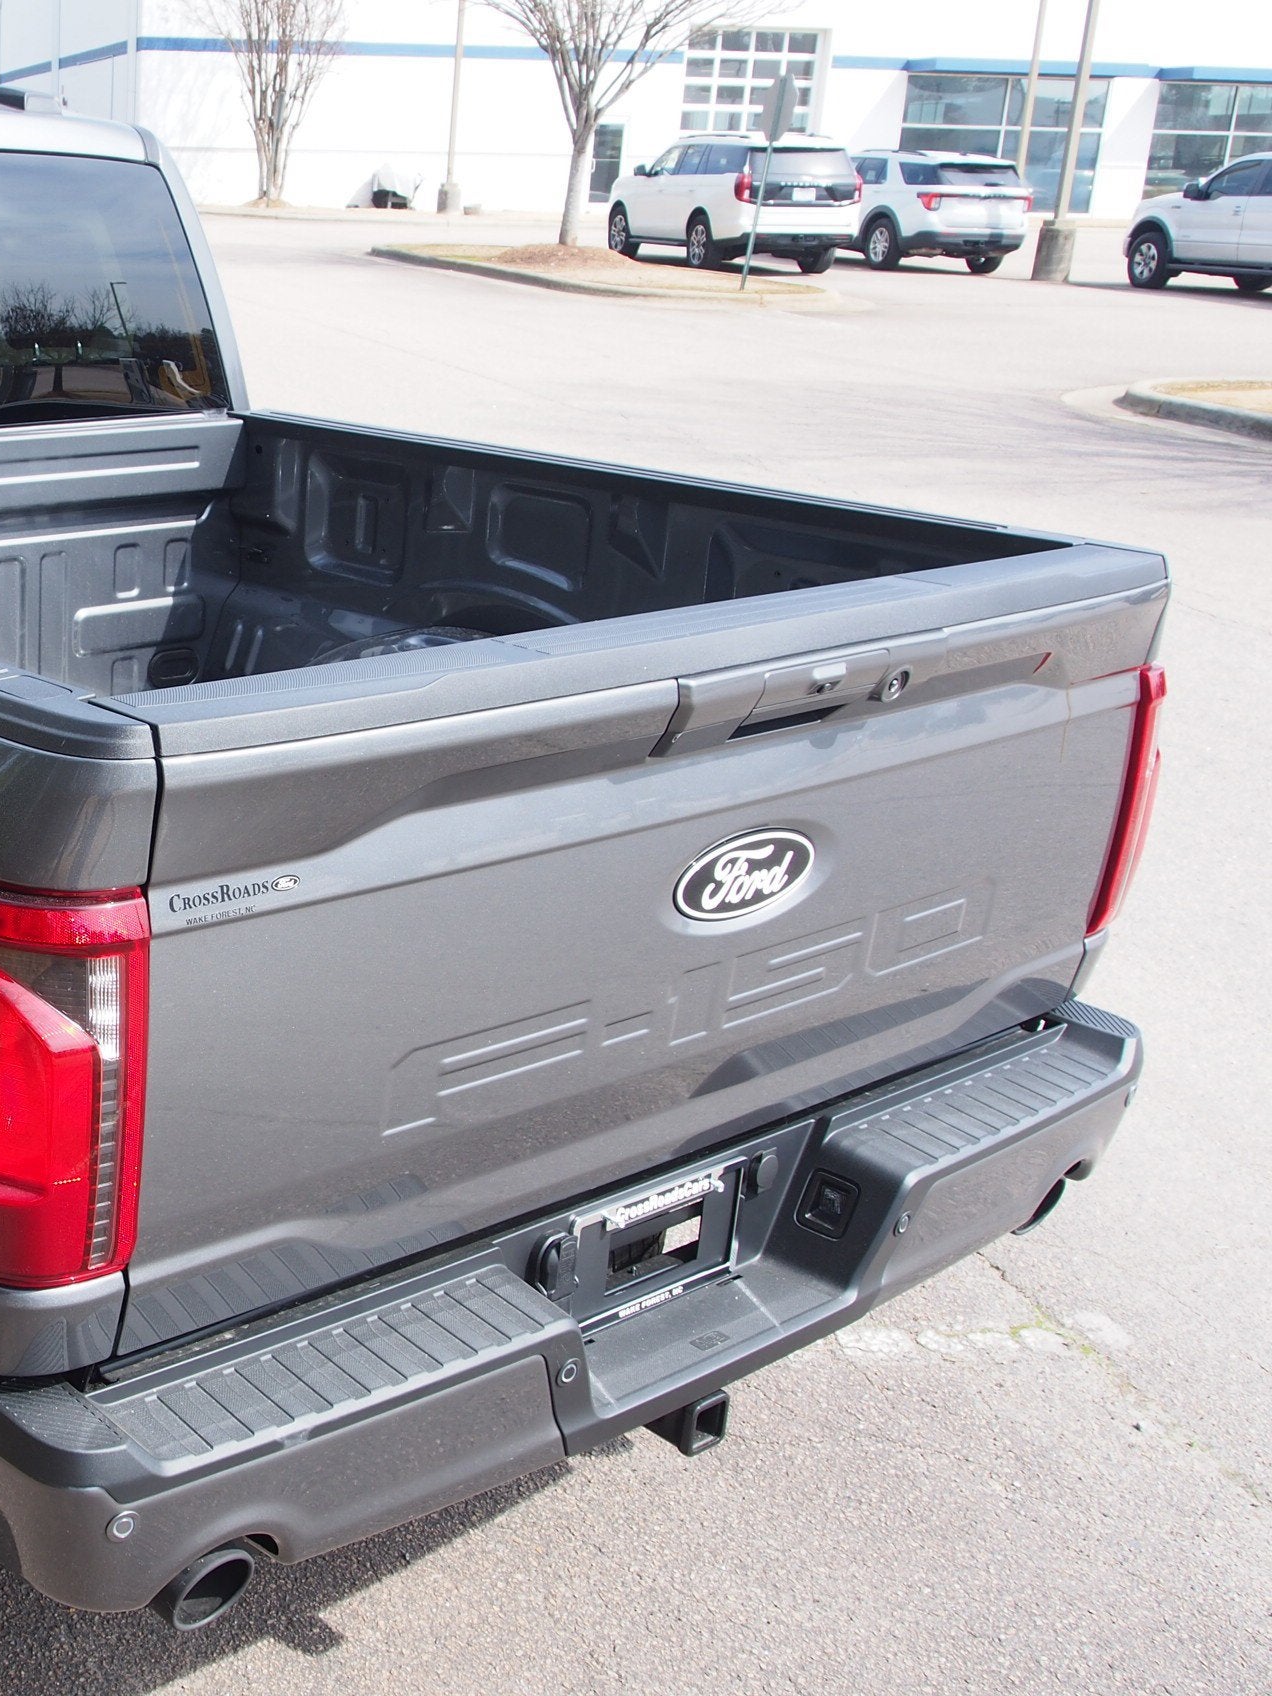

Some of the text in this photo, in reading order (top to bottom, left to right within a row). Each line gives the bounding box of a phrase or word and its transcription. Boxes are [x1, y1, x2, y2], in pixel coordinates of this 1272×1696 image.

[701, 844, 794, 911] Ford
[185, 905, 257, 926] WAKE FOREST, NC
[381, 878, 993, 1136] F-150
[618, 1303, 641, 1318] WAKE
